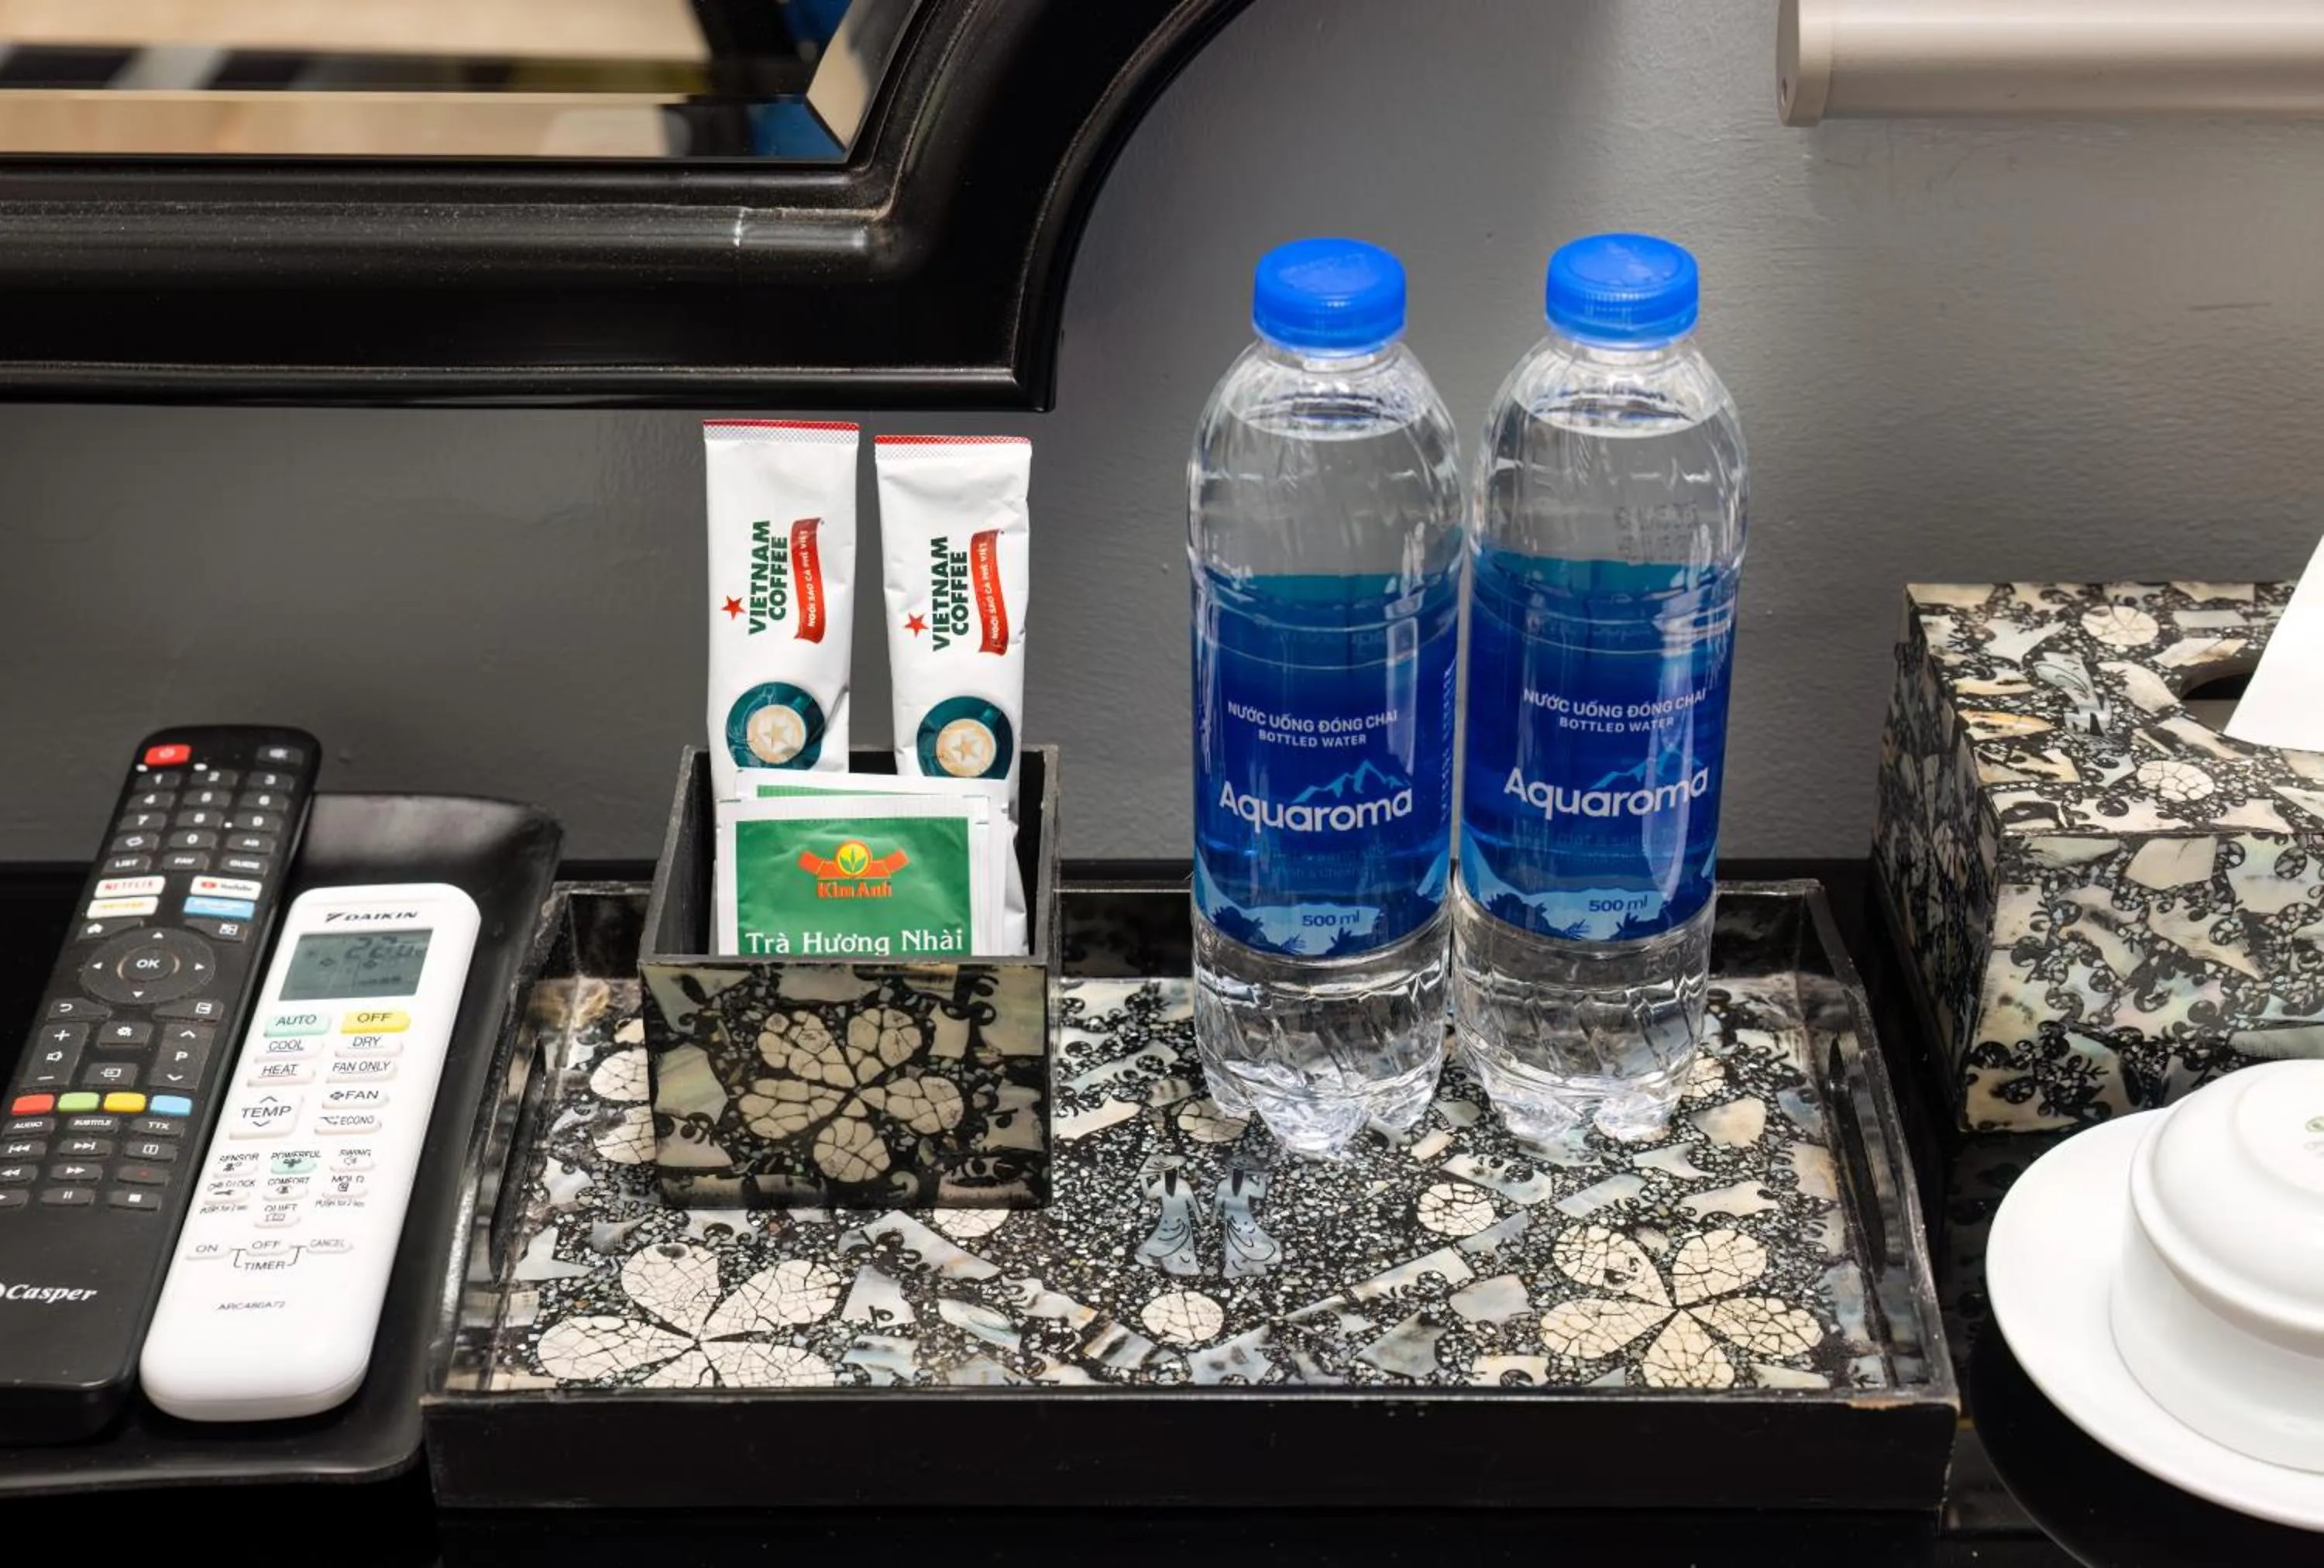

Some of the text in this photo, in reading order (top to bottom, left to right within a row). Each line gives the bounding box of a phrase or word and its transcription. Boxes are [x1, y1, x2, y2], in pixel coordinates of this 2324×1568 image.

[748, 521, 770, 634] VIETNAM
[768, 537, 787, 621] COFFEE
[930, 536, 951, 652] VIETNAM
[950, 552, 968, 636] COFFEE
[1523, 687, 1707, 717] NƯỚC UỐNG ĐÓNG CHAI
[1228, 700, 1397, 733] NƯỚC UỐNG ĐÓNG CHAI
[1559, 717, 1674, 732] BOTTLED WATER
[1259, 729, 1367, 748] BOTTLED WATER
[264, 775, 276, 785] 3
[143, 794, 156, 804] 4
[1504, 768, 1708, 820] Aquaroma
[1219, 780, 1412, 834] Aquaroma
[138, 815, 149, 825] 7
[115, 858, 138, 867] LIST
[1589, 894, 1648, 912] 500 ml
[343, 911, 419, 921] DAIKIN
[1302, 910, 1360, 927] 500 ml
[745, 930, 964, 956] Trà Hương Nhài
[136, 959, 160, 968] OK
[276, 1014, 317, 1026] AUTO
[357, 1013, 394, 1023] OFF
[268, 1039, 304, 1050] COOL
[352, 1036, 382, 1047] DRY
[174, 1051, 187, 1061] P
[261, 1064, 299, 1075] HEAT
[332, 1061, 391, 1071] FAN ONLY
[345, 1090, 379, 1100] FAN
[242, 1106, 292, 1119] TEMP
[149, 1121, 170, 1130] TTX
[340, 1116, 375, 1125] ECONO
[195, 1244, 219, 1253] ON
[252, 1240, 283, 1250] OFF
[310, 1239, 346, 1248] CANCEL
[244, 1260, 287, 1271] TIMER
[5, 1284, 98, 1304] Casper
